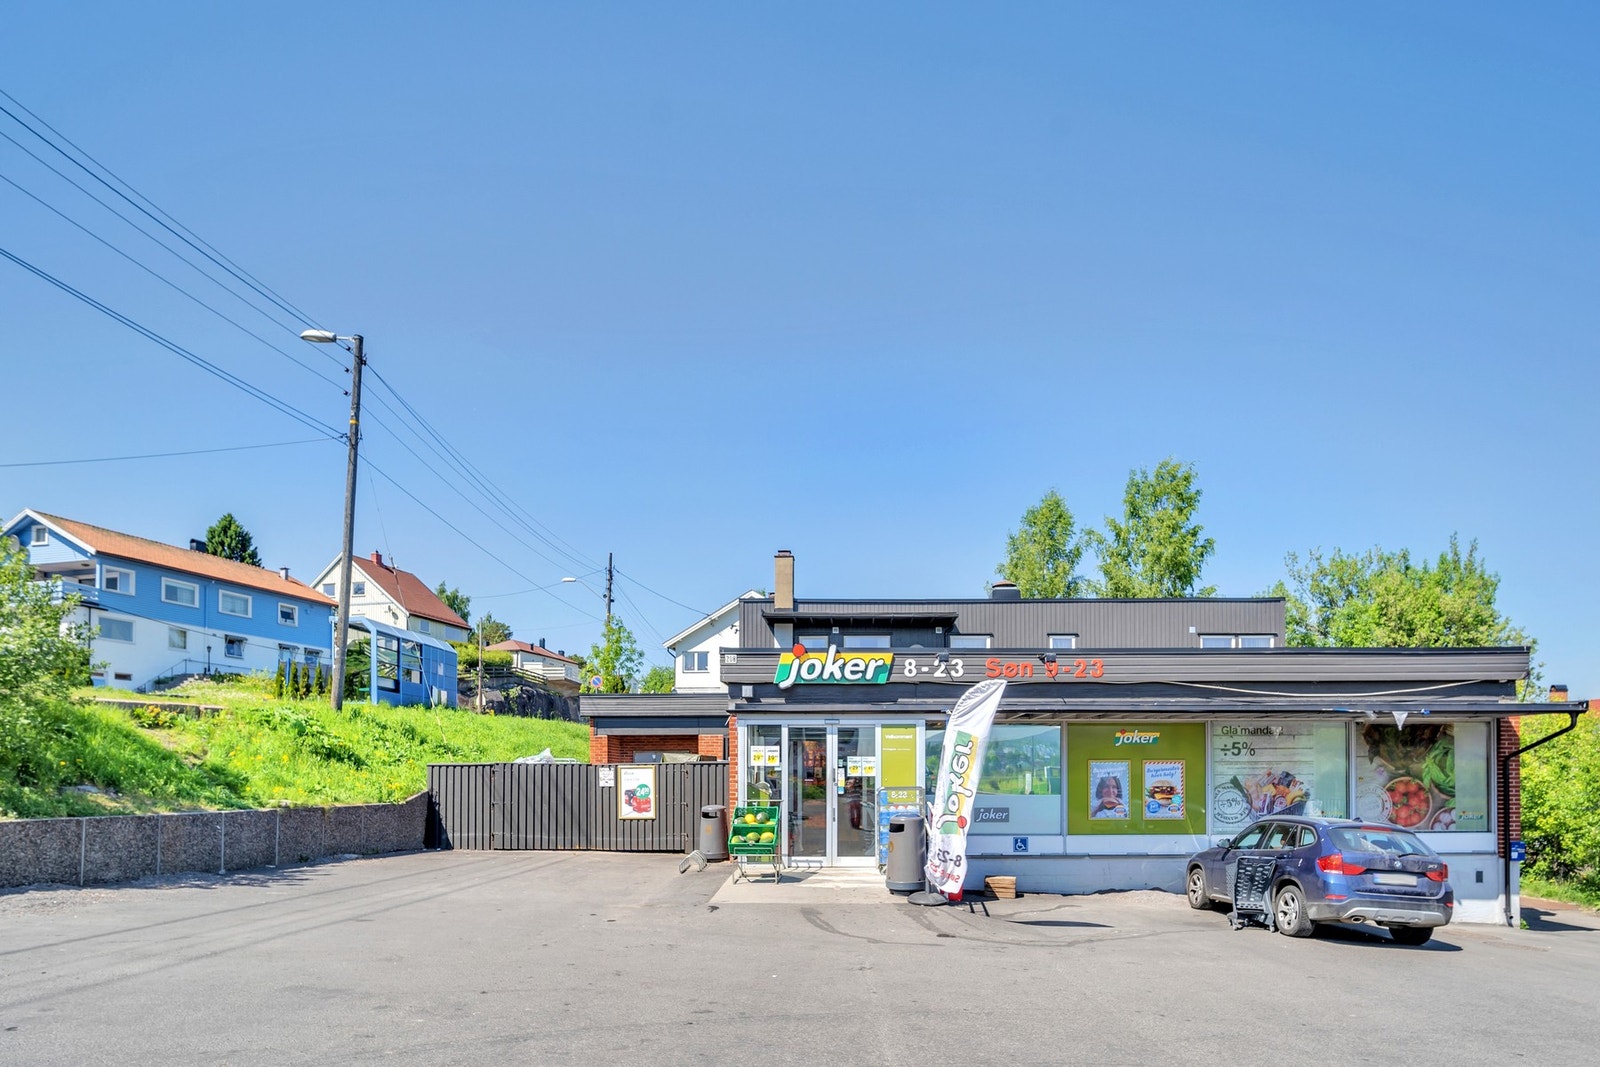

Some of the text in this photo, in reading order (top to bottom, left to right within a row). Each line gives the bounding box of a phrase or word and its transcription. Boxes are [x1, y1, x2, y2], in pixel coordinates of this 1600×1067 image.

[778, 643, 885, 690] joker
[985, 658, 1034, 678] Søn
[1115, 729, 1157, 746] joker
[976, 808, 1008, 822] joker
